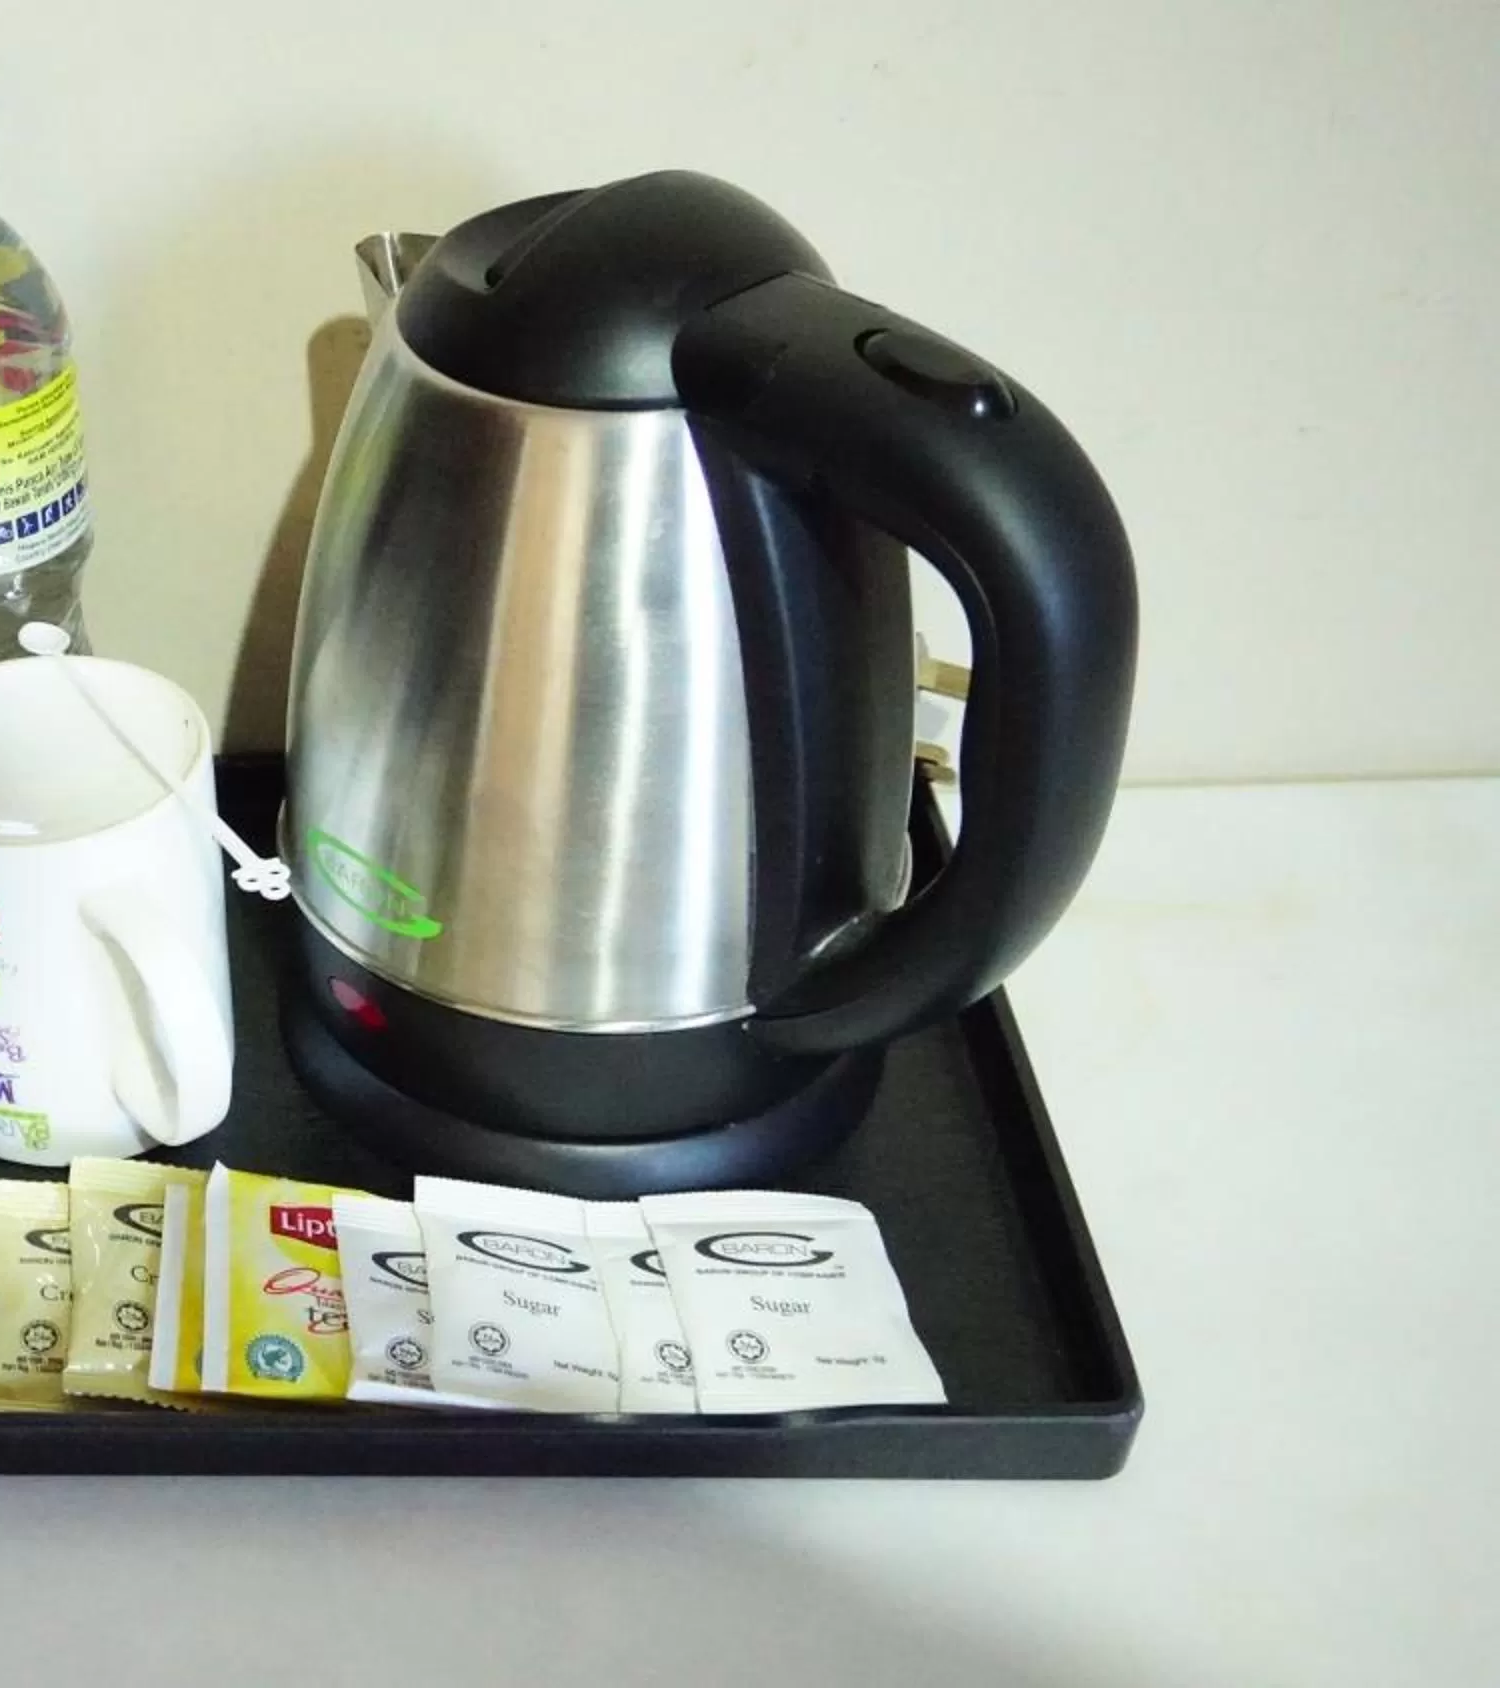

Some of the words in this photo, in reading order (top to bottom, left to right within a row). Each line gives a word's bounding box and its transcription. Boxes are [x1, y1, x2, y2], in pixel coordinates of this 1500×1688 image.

[279, 1210, 337, 1238] Lipt
[720, 1242, 809, 1257] BARON
[502, 1289, 562, 1317] Sugar
[749, 1294, 812, 1318] Sugar
